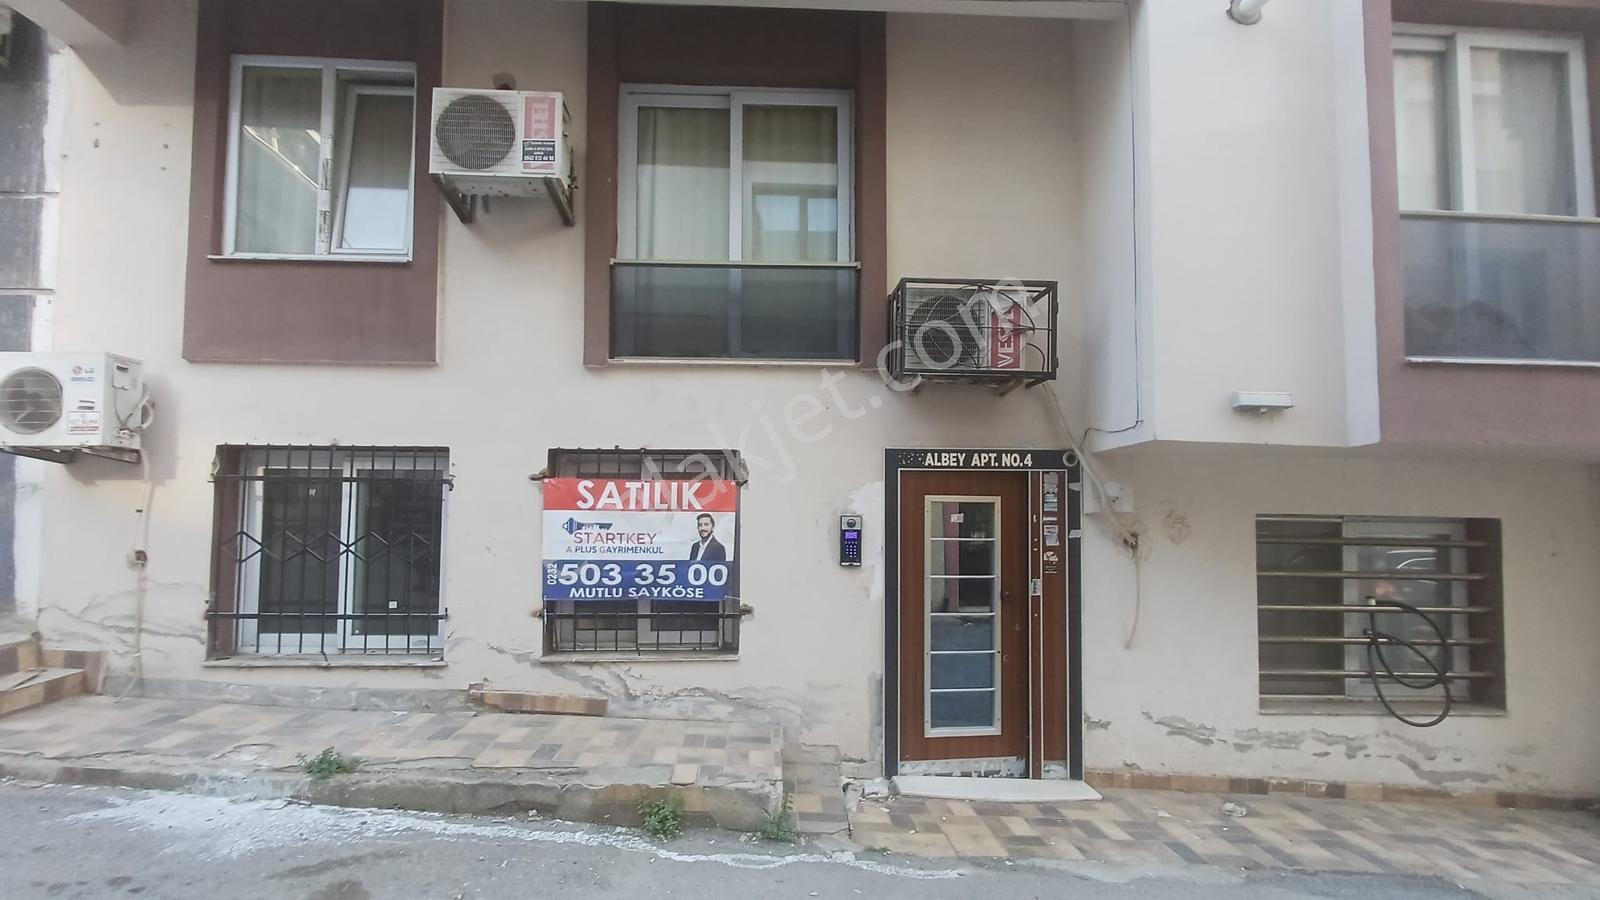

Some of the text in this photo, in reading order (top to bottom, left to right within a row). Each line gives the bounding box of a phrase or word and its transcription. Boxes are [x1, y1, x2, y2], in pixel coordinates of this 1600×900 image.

[925, 452, 966, 467] ALBEY
[971, 453, 999, 467] APT.
[573, 532, 657, 545] STARTKEY
[566, 546, 573, 554] A
[574, 546, 598, 554] PLUS
[547, 563, 558, 585] 0232
[558, 563, 728, 586] 503 35 00
[569, 585, 704, 598] MUTLU SAYKÖSE
